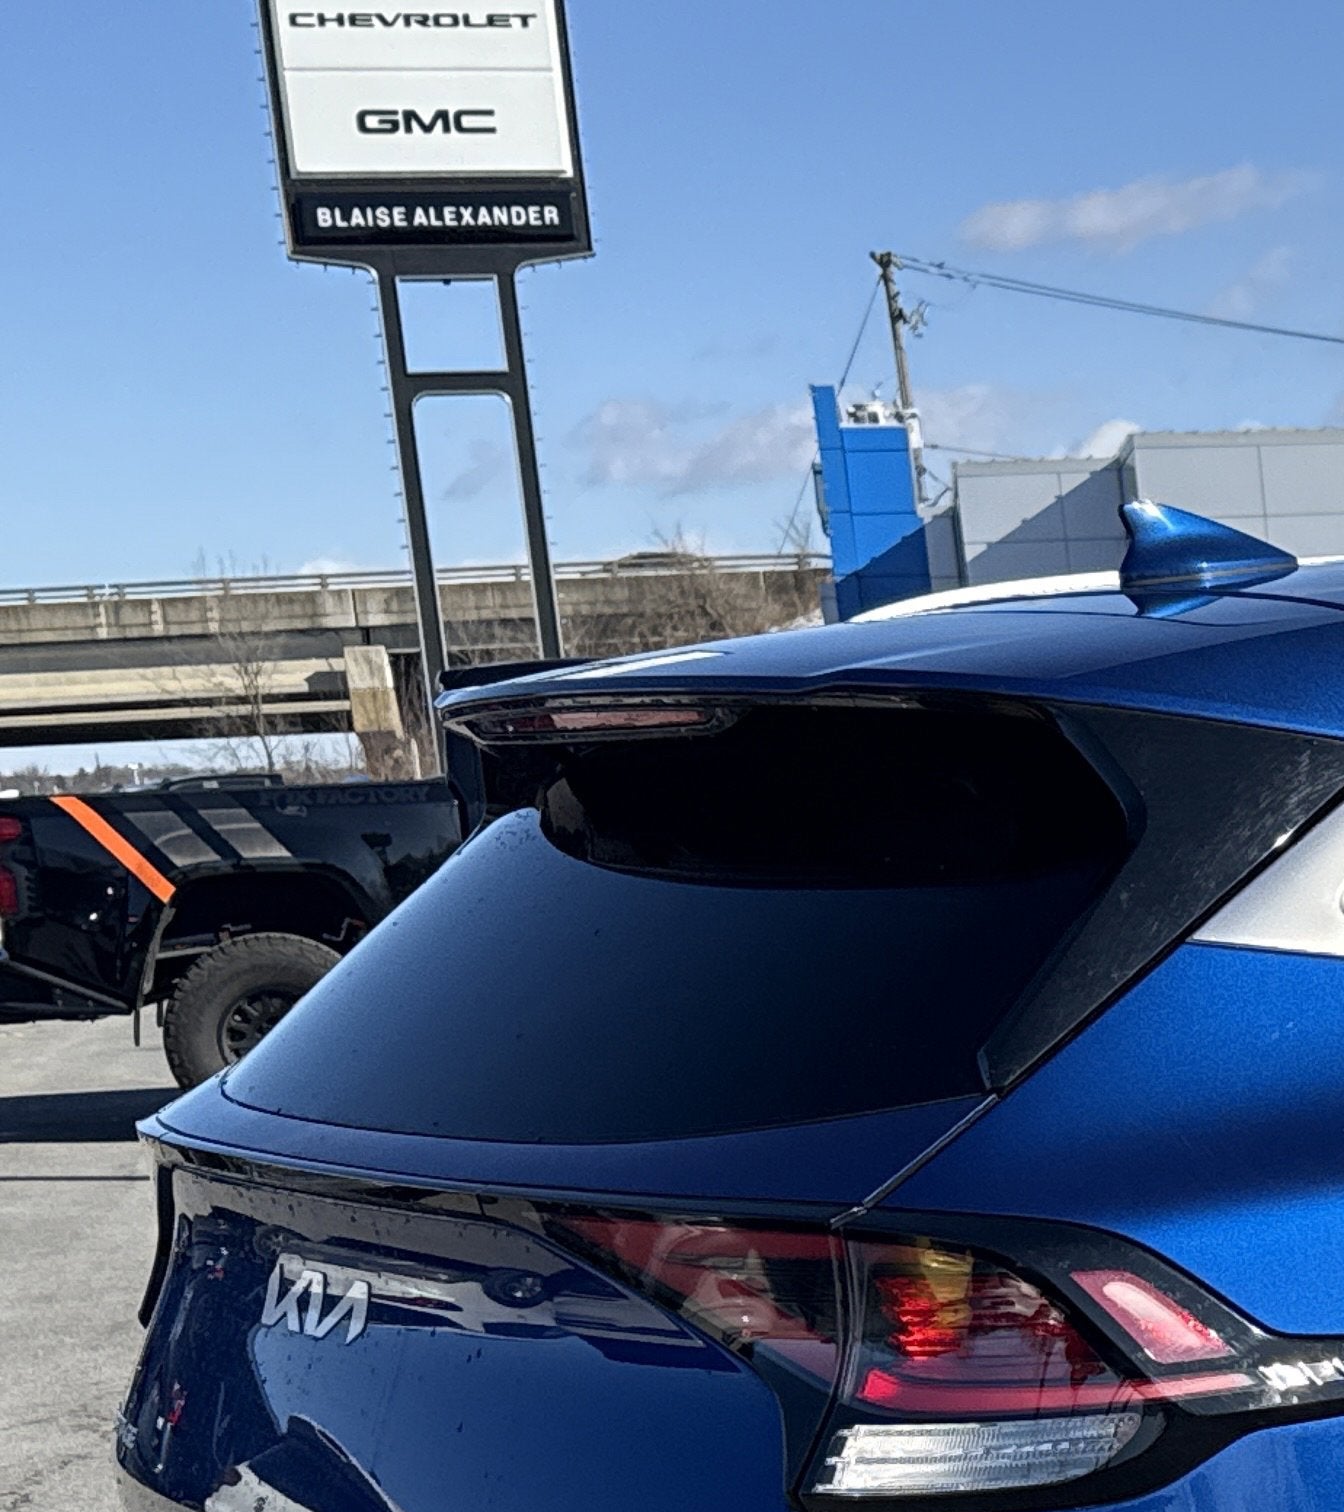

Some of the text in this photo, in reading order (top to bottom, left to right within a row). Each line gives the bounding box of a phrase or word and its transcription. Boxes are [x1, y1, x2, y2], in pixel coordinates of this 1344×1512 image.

[288, 12, 538, 29] CHEVROLET
[355, 108, 498, 135] GMC
[316, 204, 560, 229] BLAISE ALEXANDER
